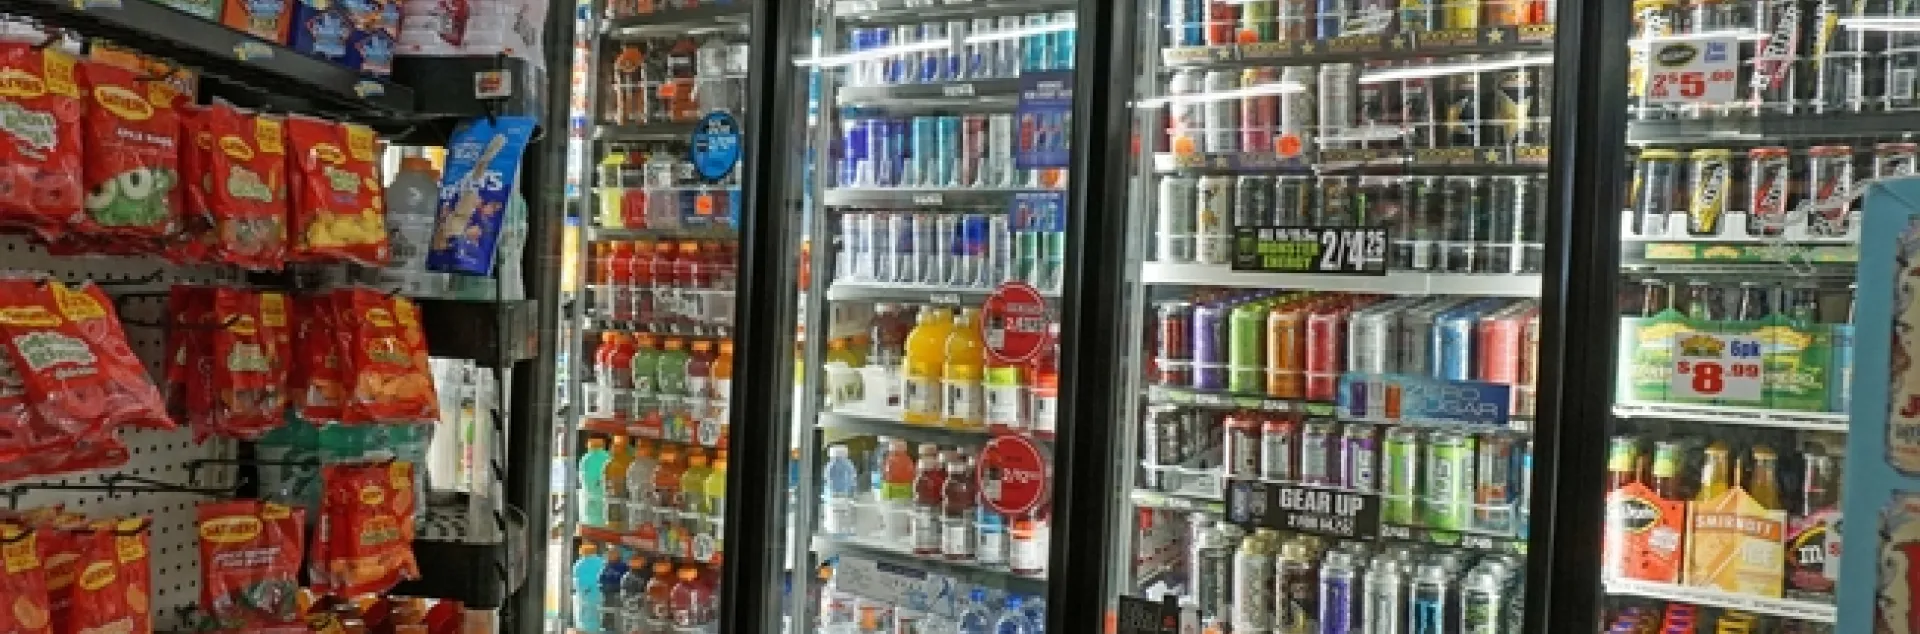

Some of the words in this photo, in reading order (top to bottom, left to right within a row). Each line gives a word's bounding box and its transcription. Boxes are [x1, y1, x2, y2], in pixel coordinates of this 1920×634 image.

[1731, 338, 1761, 358] 6pk
[1677, 361, 1760, 394] $8.99
[1278, 488, 1332, 514] GEAR
[1335, 494, 1363, 517] UP
[1695, 513, 1775, 536] SMIRNOFF
